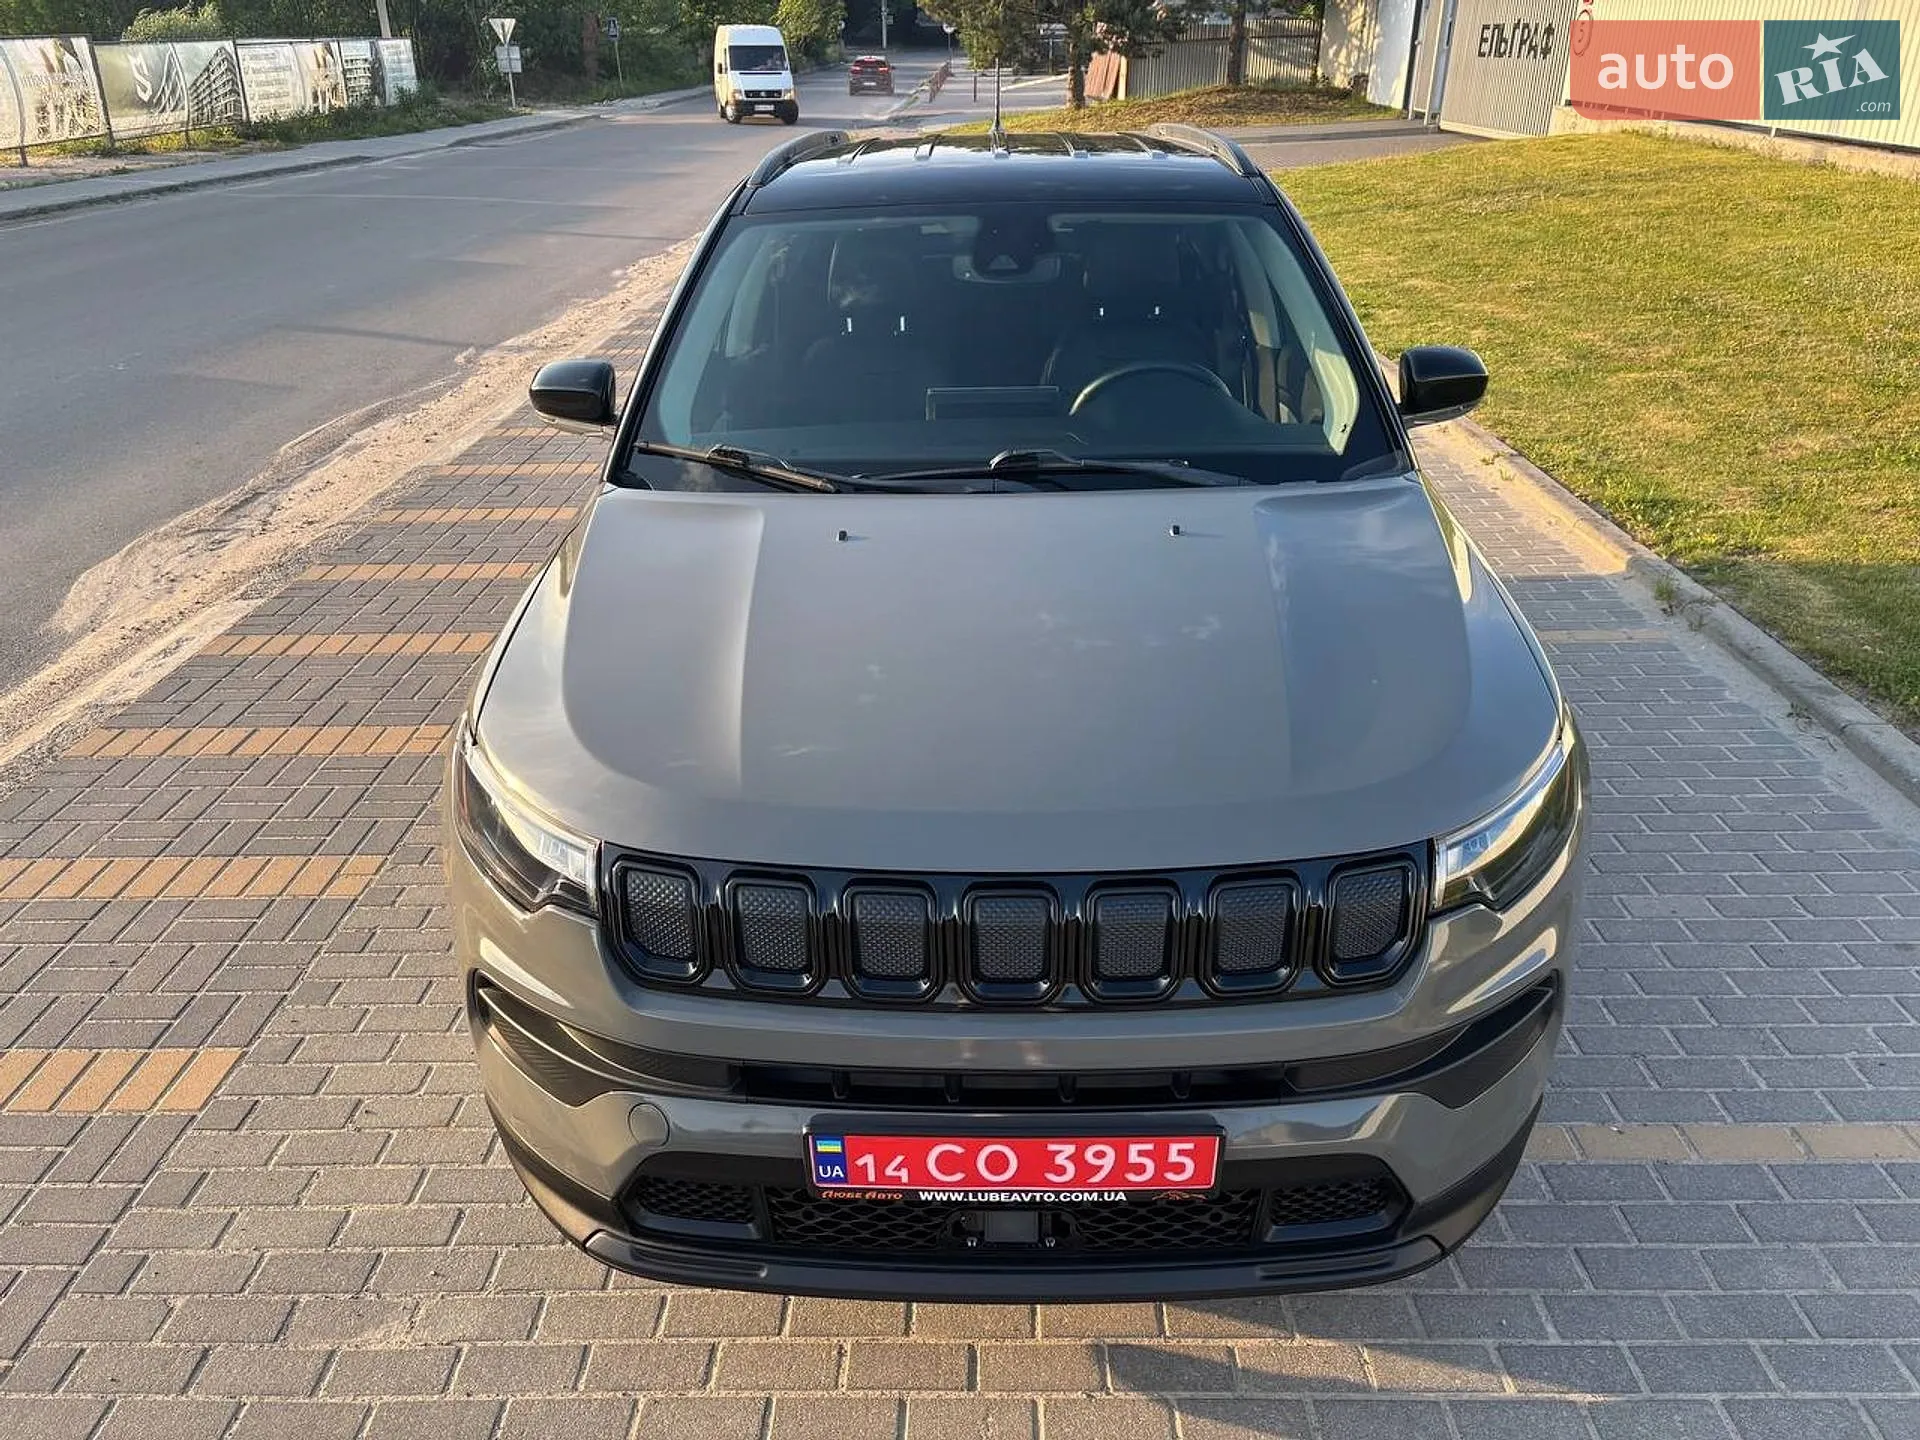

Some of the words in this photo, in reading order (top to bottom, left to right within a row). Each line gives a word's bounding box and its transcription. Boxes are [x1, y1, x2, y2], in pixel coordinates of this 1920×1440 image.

[855, 1153, 909, 1184] 14
[926, 1143, 1018, 1182] CO
[1044, 1142, 1195, 1183] 3955
[819, 1165, 844, 1178] UA
[918, 1191, 1127, 1202] WWW.LUBEAVTO.COM.UA
